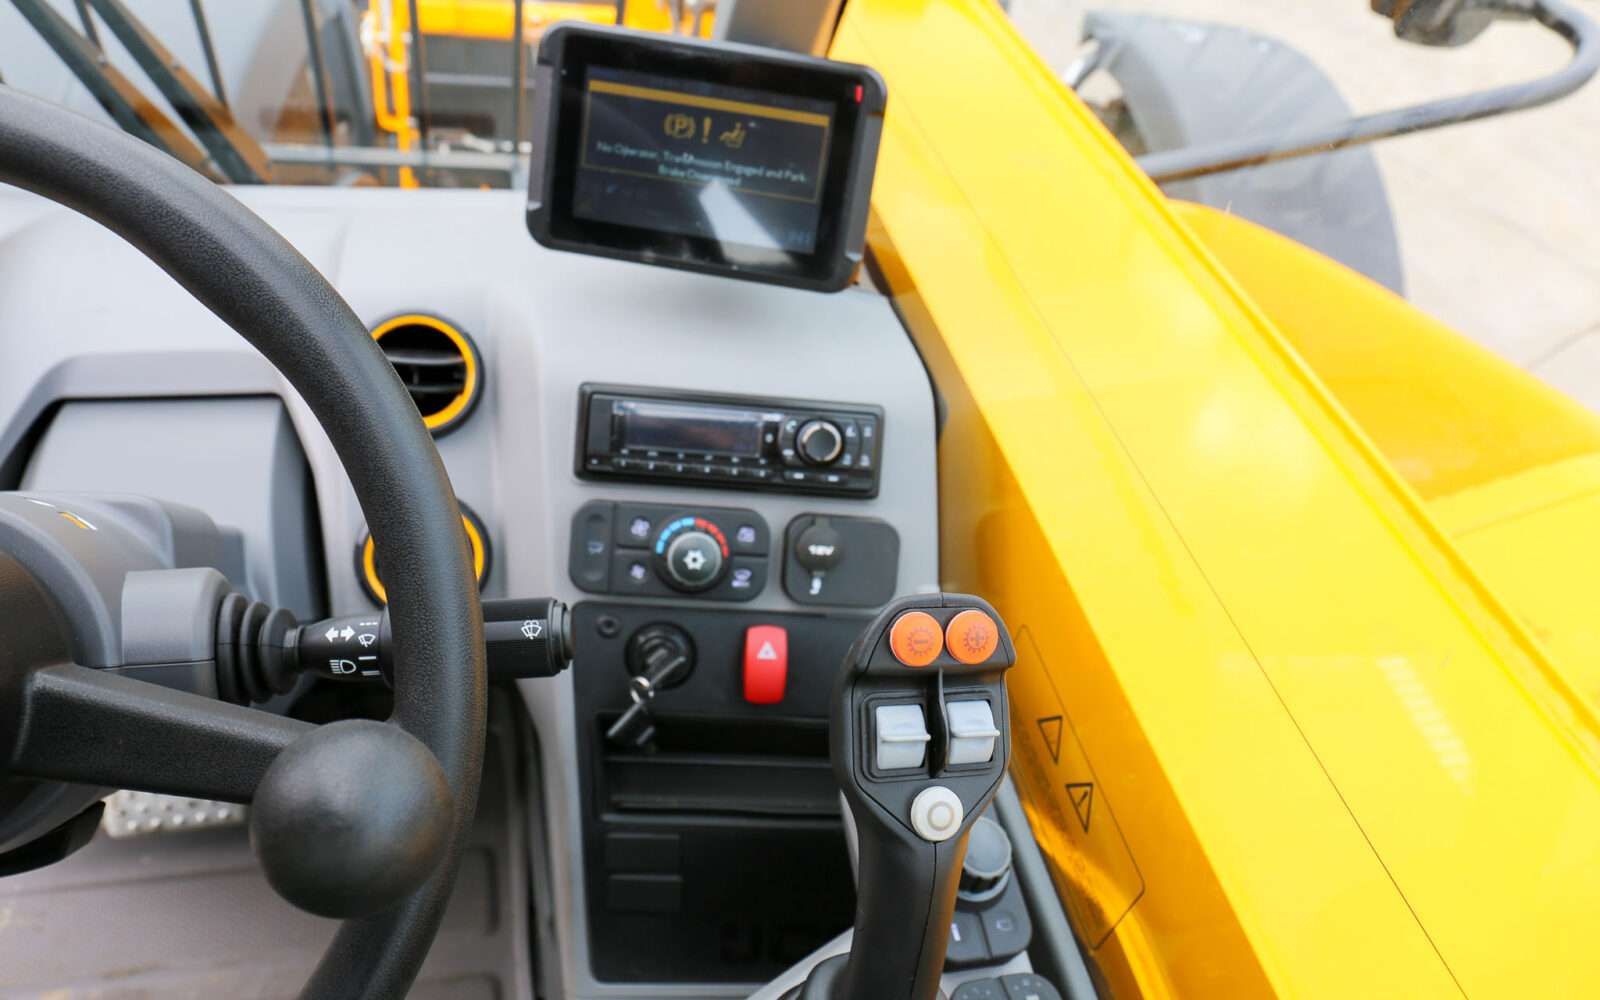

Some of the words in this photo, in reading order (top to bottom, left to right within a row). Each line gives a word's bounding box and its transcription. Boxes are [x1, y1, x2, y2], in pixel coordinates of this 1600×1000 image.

[596, 140, 613, 153] No
[723, 160, 764, 177] Engaged
[765, 168, 784, 180] and
[658, 163, 685, 179] Brake
